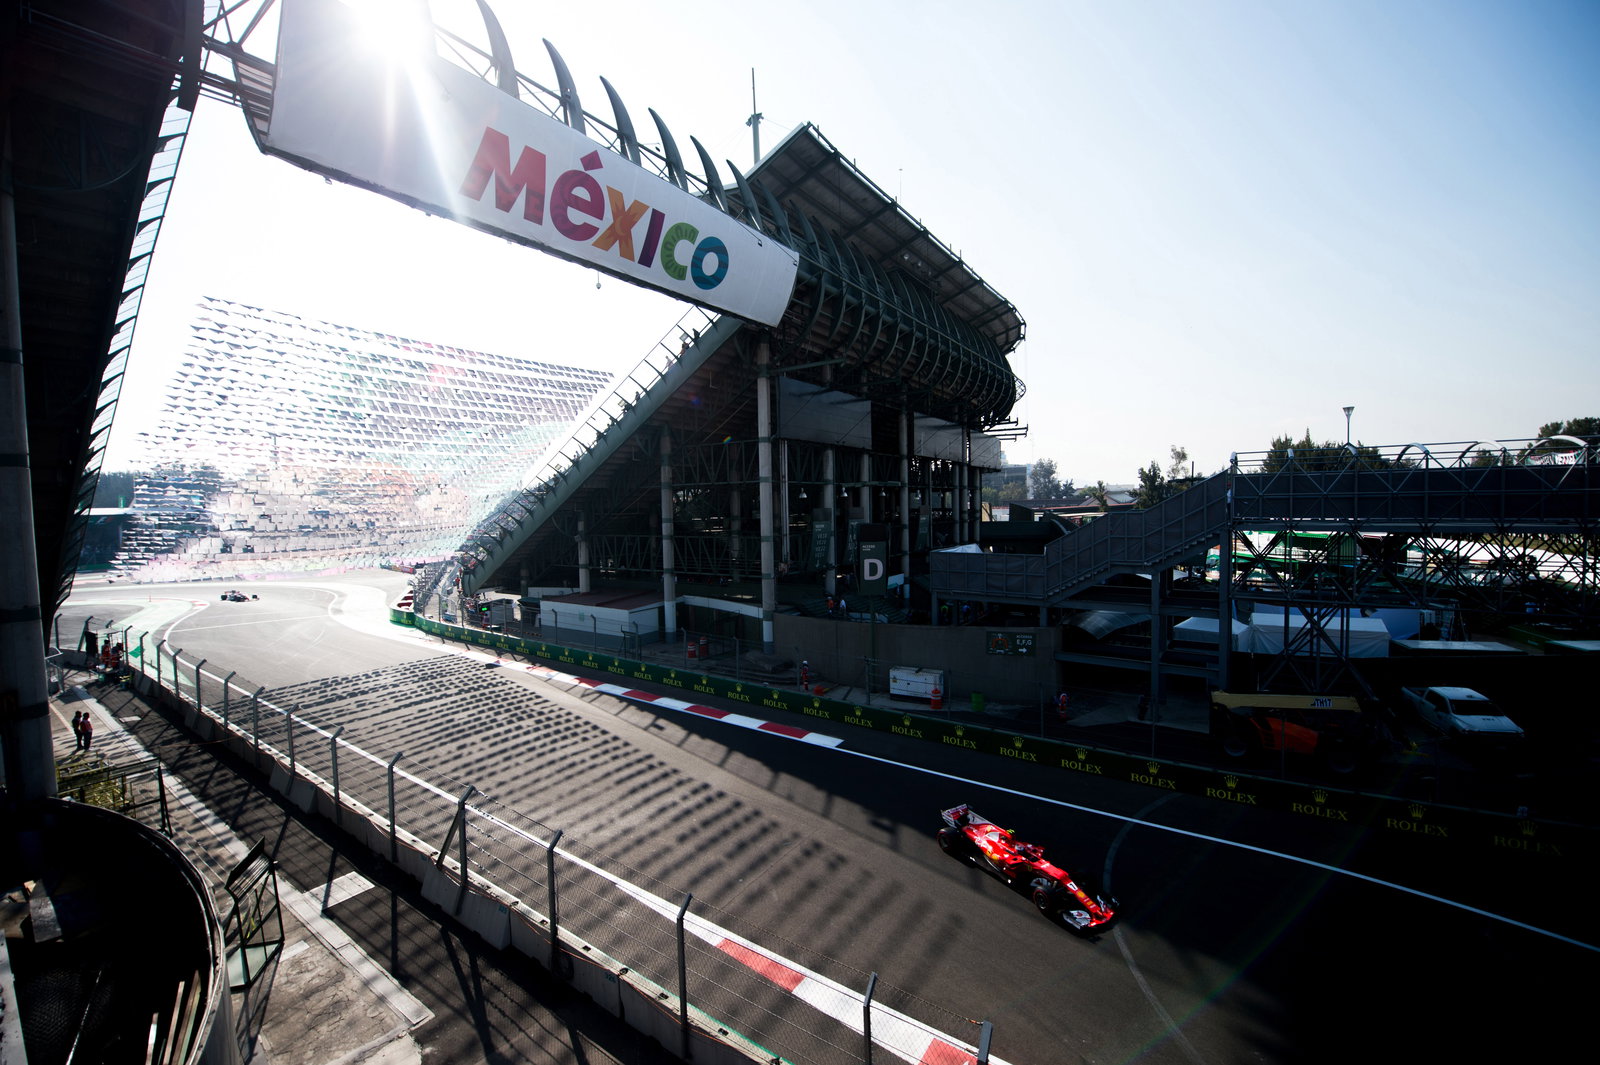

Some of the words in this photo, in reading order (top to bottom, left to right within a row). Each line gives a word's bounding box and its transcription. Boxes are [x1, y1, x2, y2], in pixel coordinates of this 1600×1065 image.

[459, 126, 729, 291] México
[863, 558, 884, 581] D
[558, 656, 574, 664] ROLEX
[582, 660, 598, 668] ROLEX
[608, 666, 624, 674] ROLEX
[634, 671, 652, 680] ROLEX
[663, 678, 682, 687] ROLEX
[694, 684, 714, 694] ROLEX
[728, 691, 750, 702] ROLEX
[764, 699, 788, 710] ROLEX
[804, 707, 830, 719] ROLEX
[844, 715, 872, 728] ROLEX
[892, 725, 923, 738] ROLEX
[943, 735, 976, 750] ROLEX
[1000, 746, 1038, 762] ROLEX
[1061, 759, 1103, 774] ROLEX
[1130, 772, 1176, 790] ROLEX
[1206, 787, 1257, 804] ROLEX
[1291, 802, 1349, 821] ROLEX
[1386, 817, 1449, 838] ROLEX
[1493, 834, 1564, 856] ROLEX
